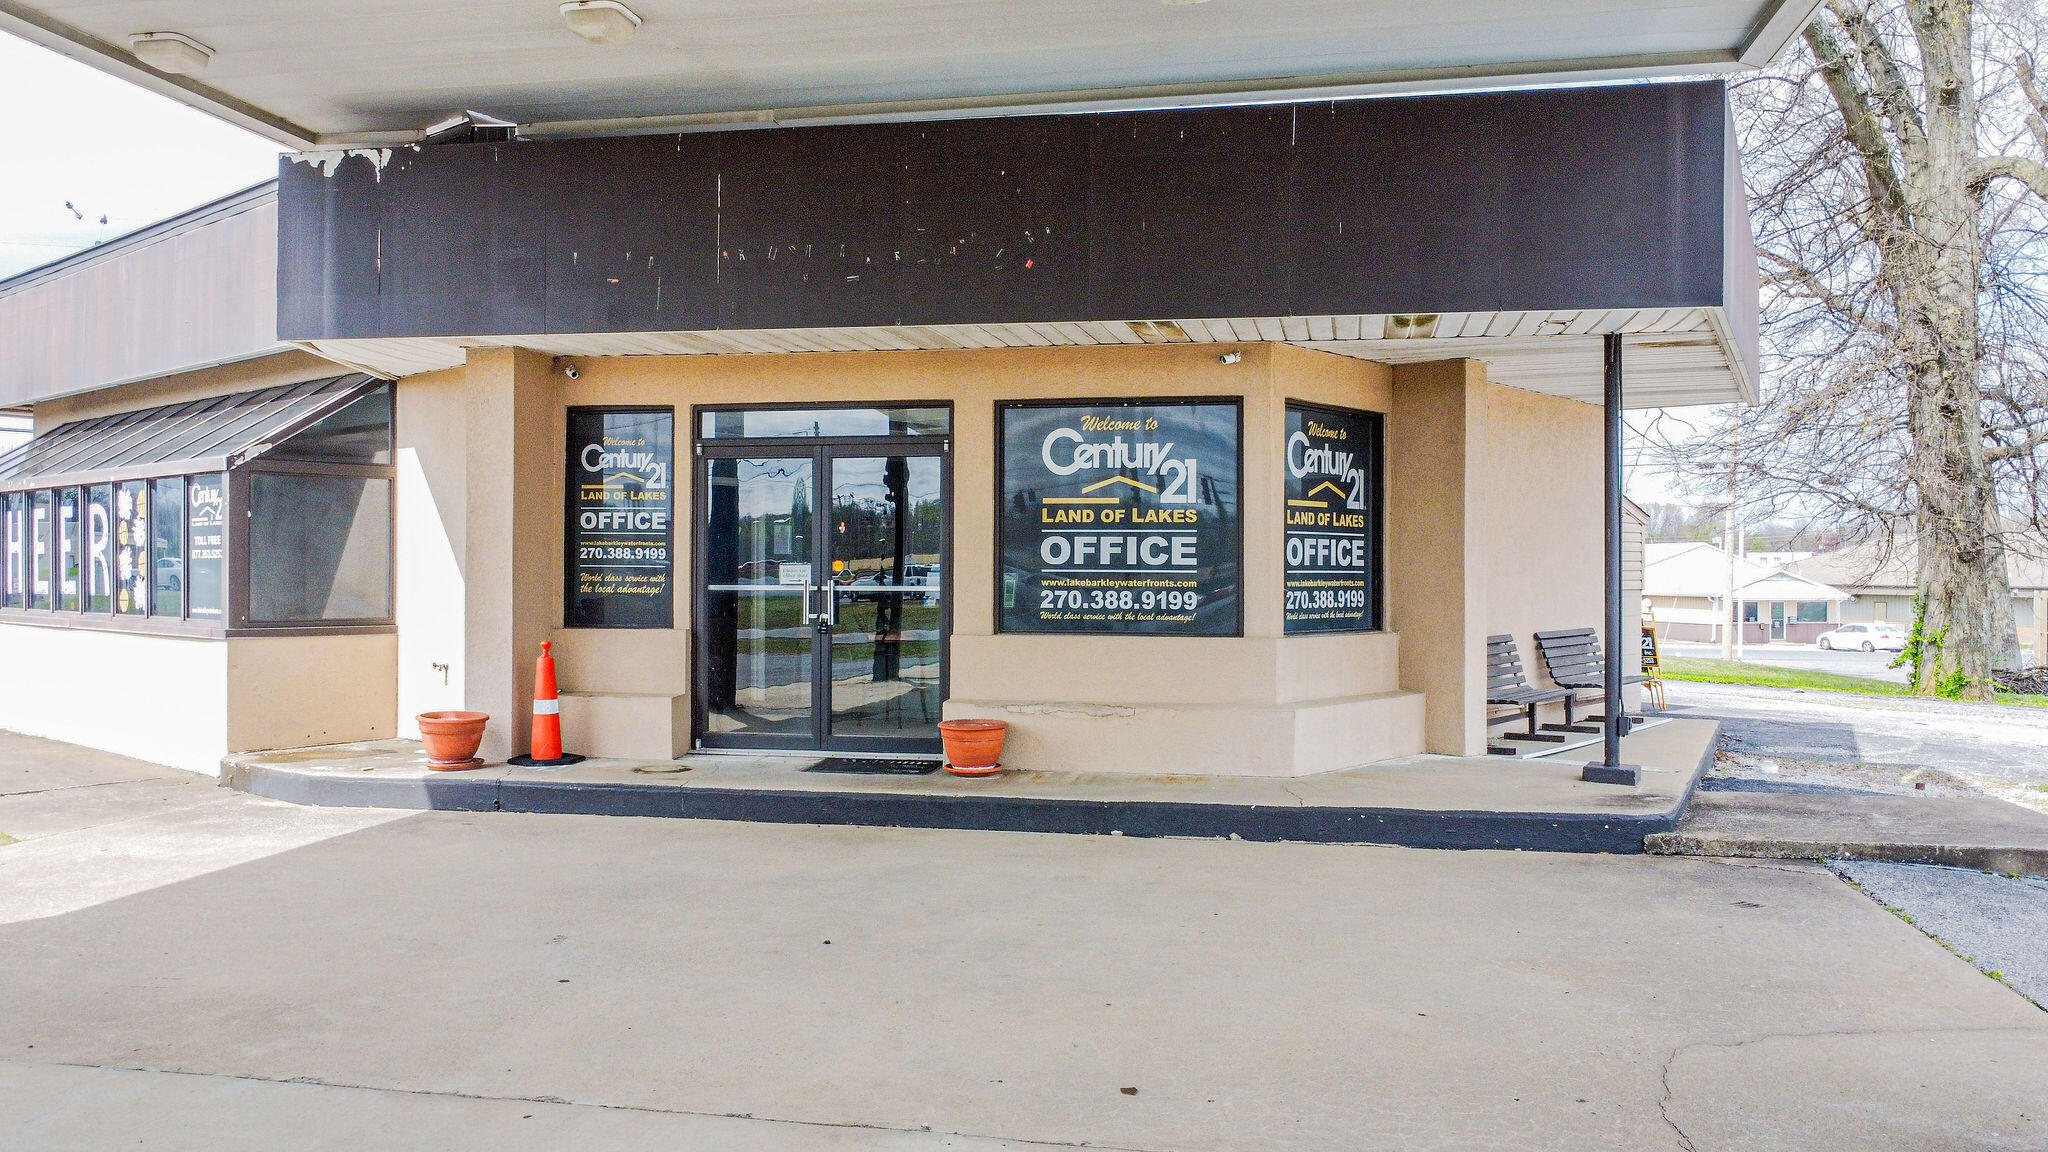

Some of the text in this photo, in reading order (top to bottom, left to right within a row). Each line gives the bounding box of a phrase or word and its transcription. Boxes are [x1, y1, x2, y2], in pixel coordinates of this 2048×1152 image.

[1080, 414, 1159, 431] Welcome to
[1308, 420, 1347, 440] Welcome to
[602, 436, 646, 446] Welcome to
[581, 443, 667, 489] Century 21
[1041, 427, 1197, 504] Century 21
[1287, 430, 1365, 510] Century 21
[581, 491, 667, 500] LAND OF LAKES
[580, 511, 667, 530] OFFICE
[1041, 507, 1198, 523] LAND OF LAKES
[1286, 509, 1364, 528] LAND OF LAKES
[193, 535, 222, 546] TOLL FREE
[579, 547, 667, 559] 270.388.9199
[1040, 535, 1198, 566] OFFICE
[1286, 537, 1365, 567] OFFICE
[580, 572, 666, 582] World class service with
[1041, 578, 1198, 588] www.lakebarkleywaterfronts.com
[580, 583, 666, 597] the local advantage!
[1039, 590, 1198, 611] 270.388.9199
[1285, 589, 1365, 610] 270.388.9199
[1039, 611, 1197, 624] World class service with the local advantage!
[1641, 636, 1654, 650] 21
